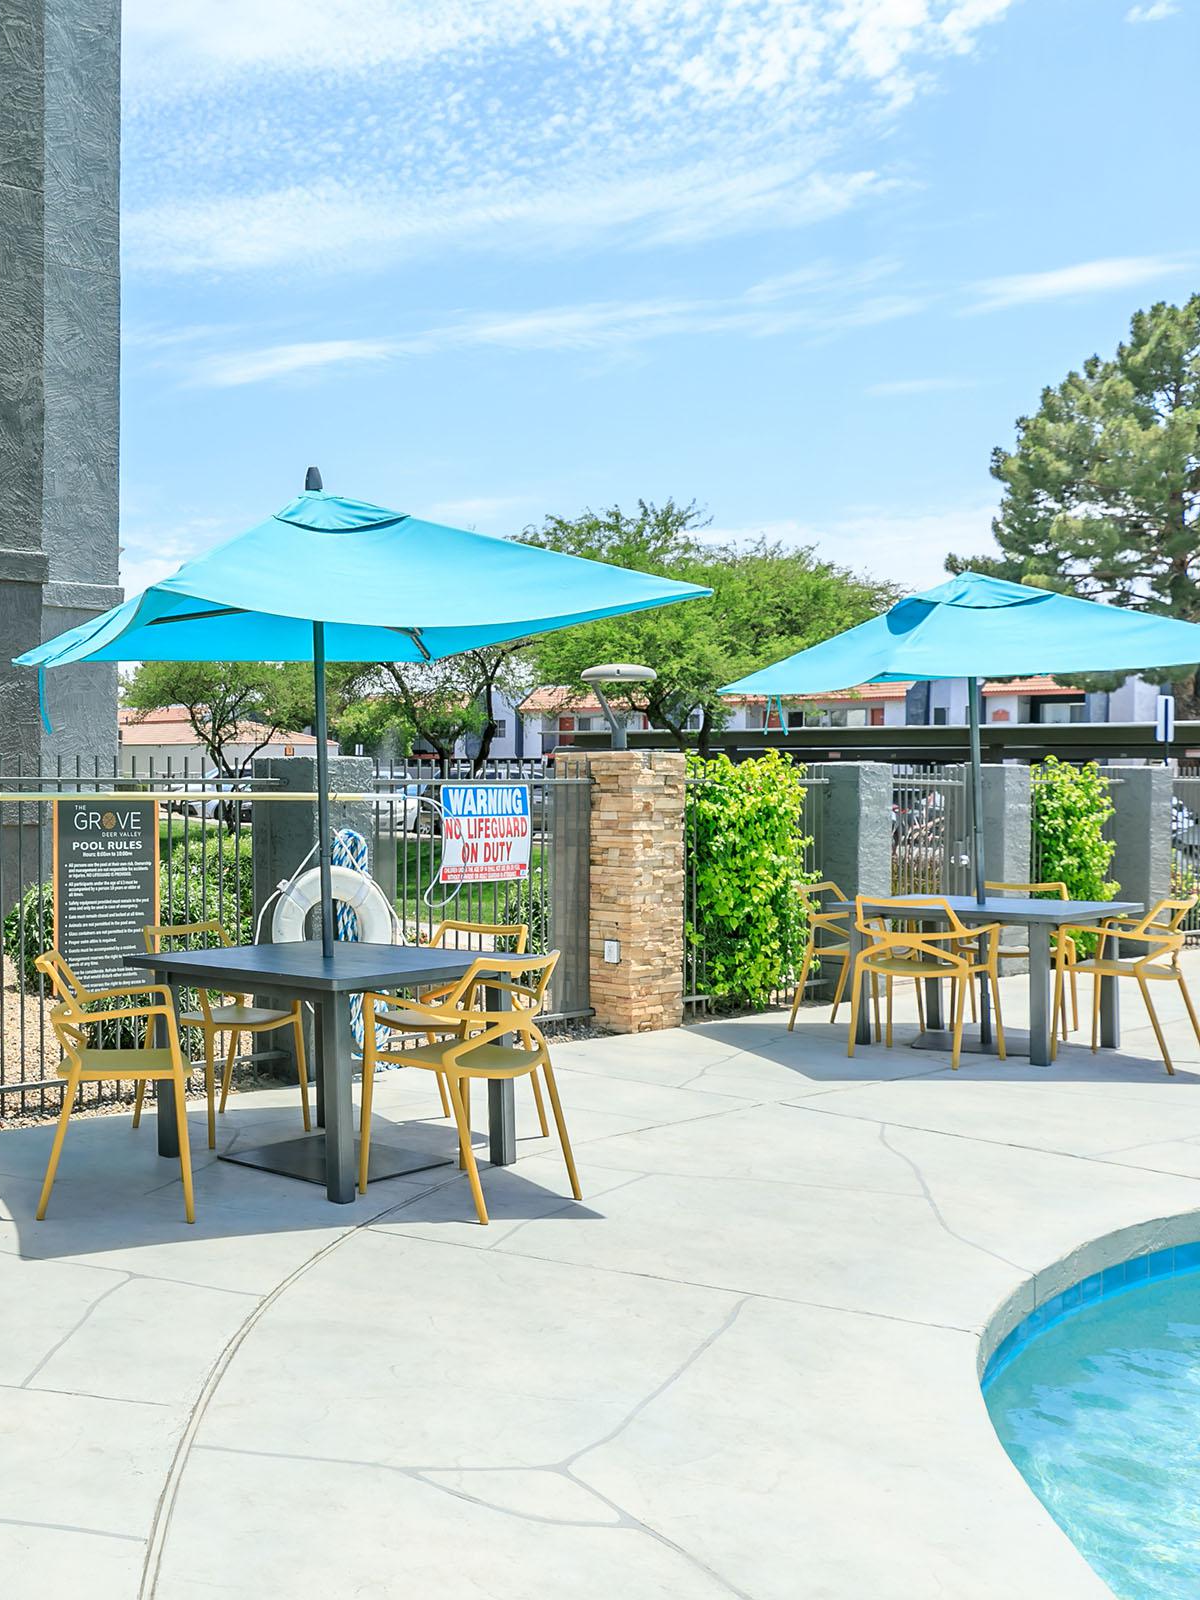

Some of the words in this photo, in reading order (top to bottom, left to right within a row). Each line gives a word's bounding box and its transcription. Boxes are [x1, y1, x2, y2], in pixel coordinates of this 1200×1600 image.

[448, 788, 522, 815] WARNING
[74, 811, 141, 830] GROVE
[445, 818, 461, 840] NO
[467, 817, 528, 839] LIFEGUARD
[72, 841, 105, 851] POOL
[108, 841, 143, 850] RULES
[461, 842, 479, 864] ON
[484, 841, 513, 863] DUTY
